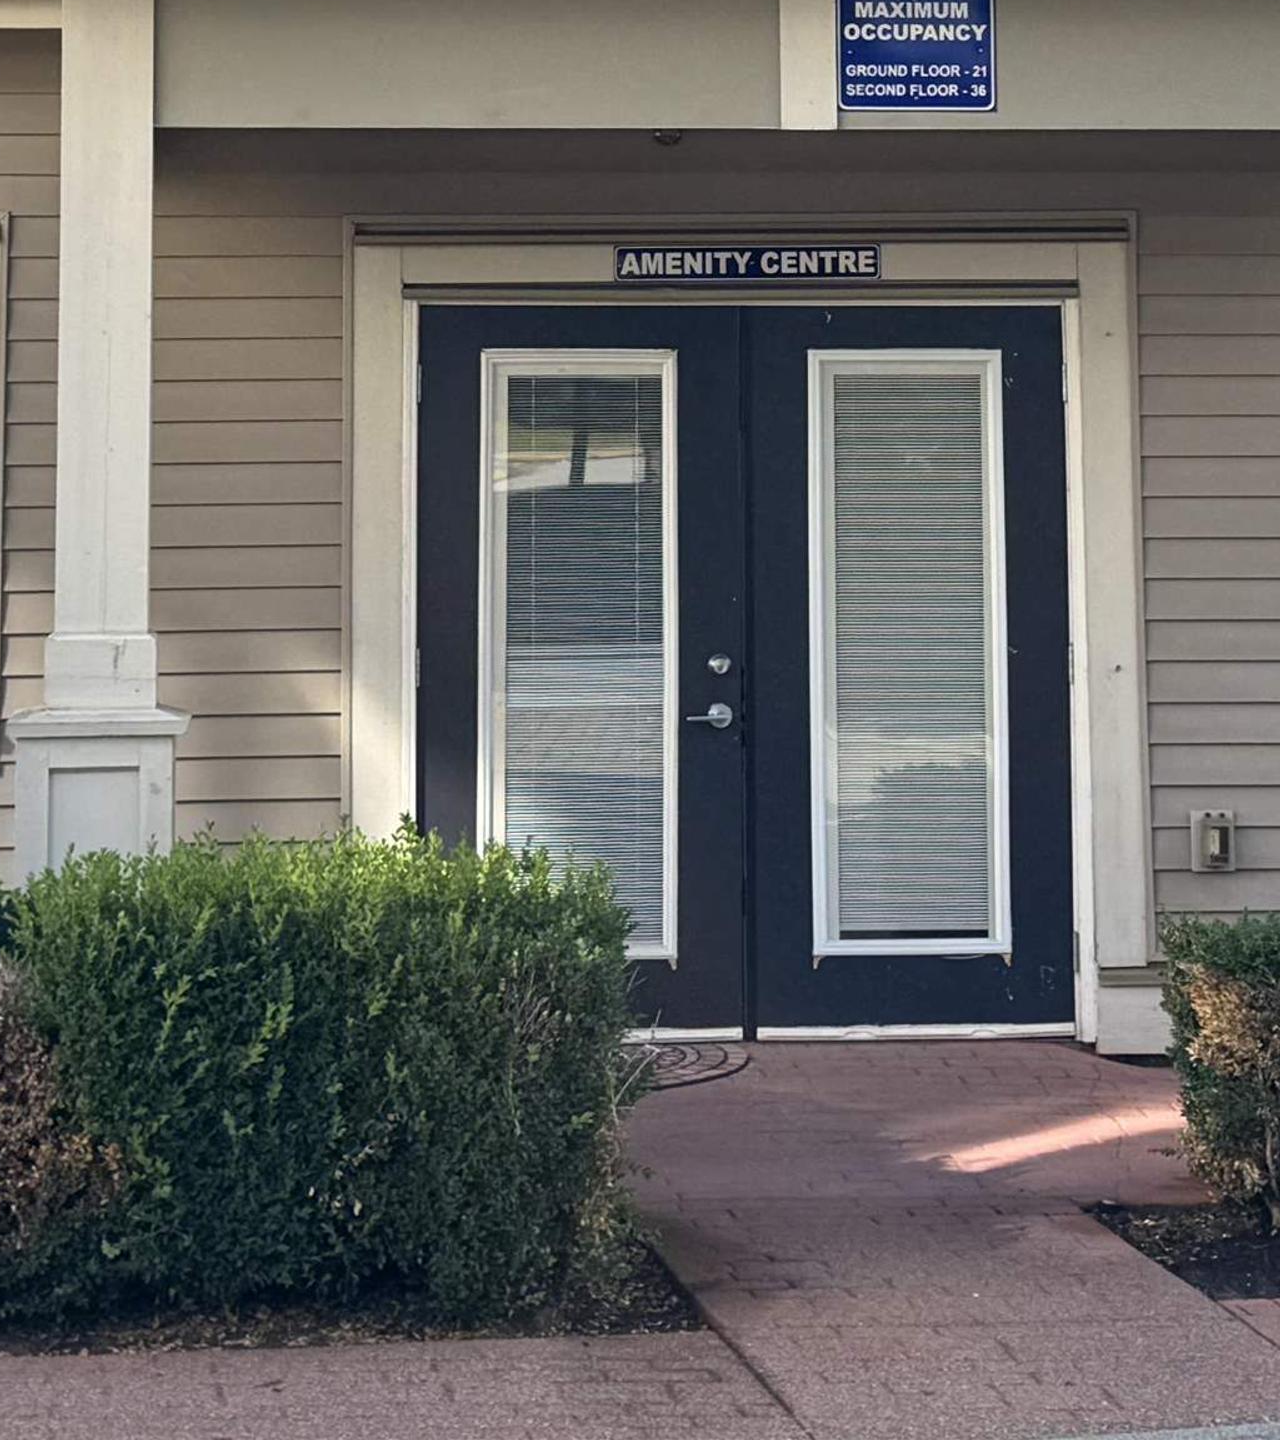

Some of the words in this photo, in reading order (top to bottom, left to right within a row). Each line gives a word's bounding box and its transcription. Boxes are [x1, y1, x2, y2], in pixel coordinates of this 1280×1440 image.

[854, 1, 969, 19] MAXIMUM
[843, 23, 988, 42] OCCUPANCY
[845, 64, 908, 78] GROUND
[911, 64, 961, 77] FLOOR
[972, 65, 988, 77] 21
[845, 84, 906, 97] SECOND
[909, 84, 960, 97] FLOOR
[971, 84, 987, 97] 36
[620, 251, 752, 276] AMENITY
[760, 250, 876, 275] CENTRE
